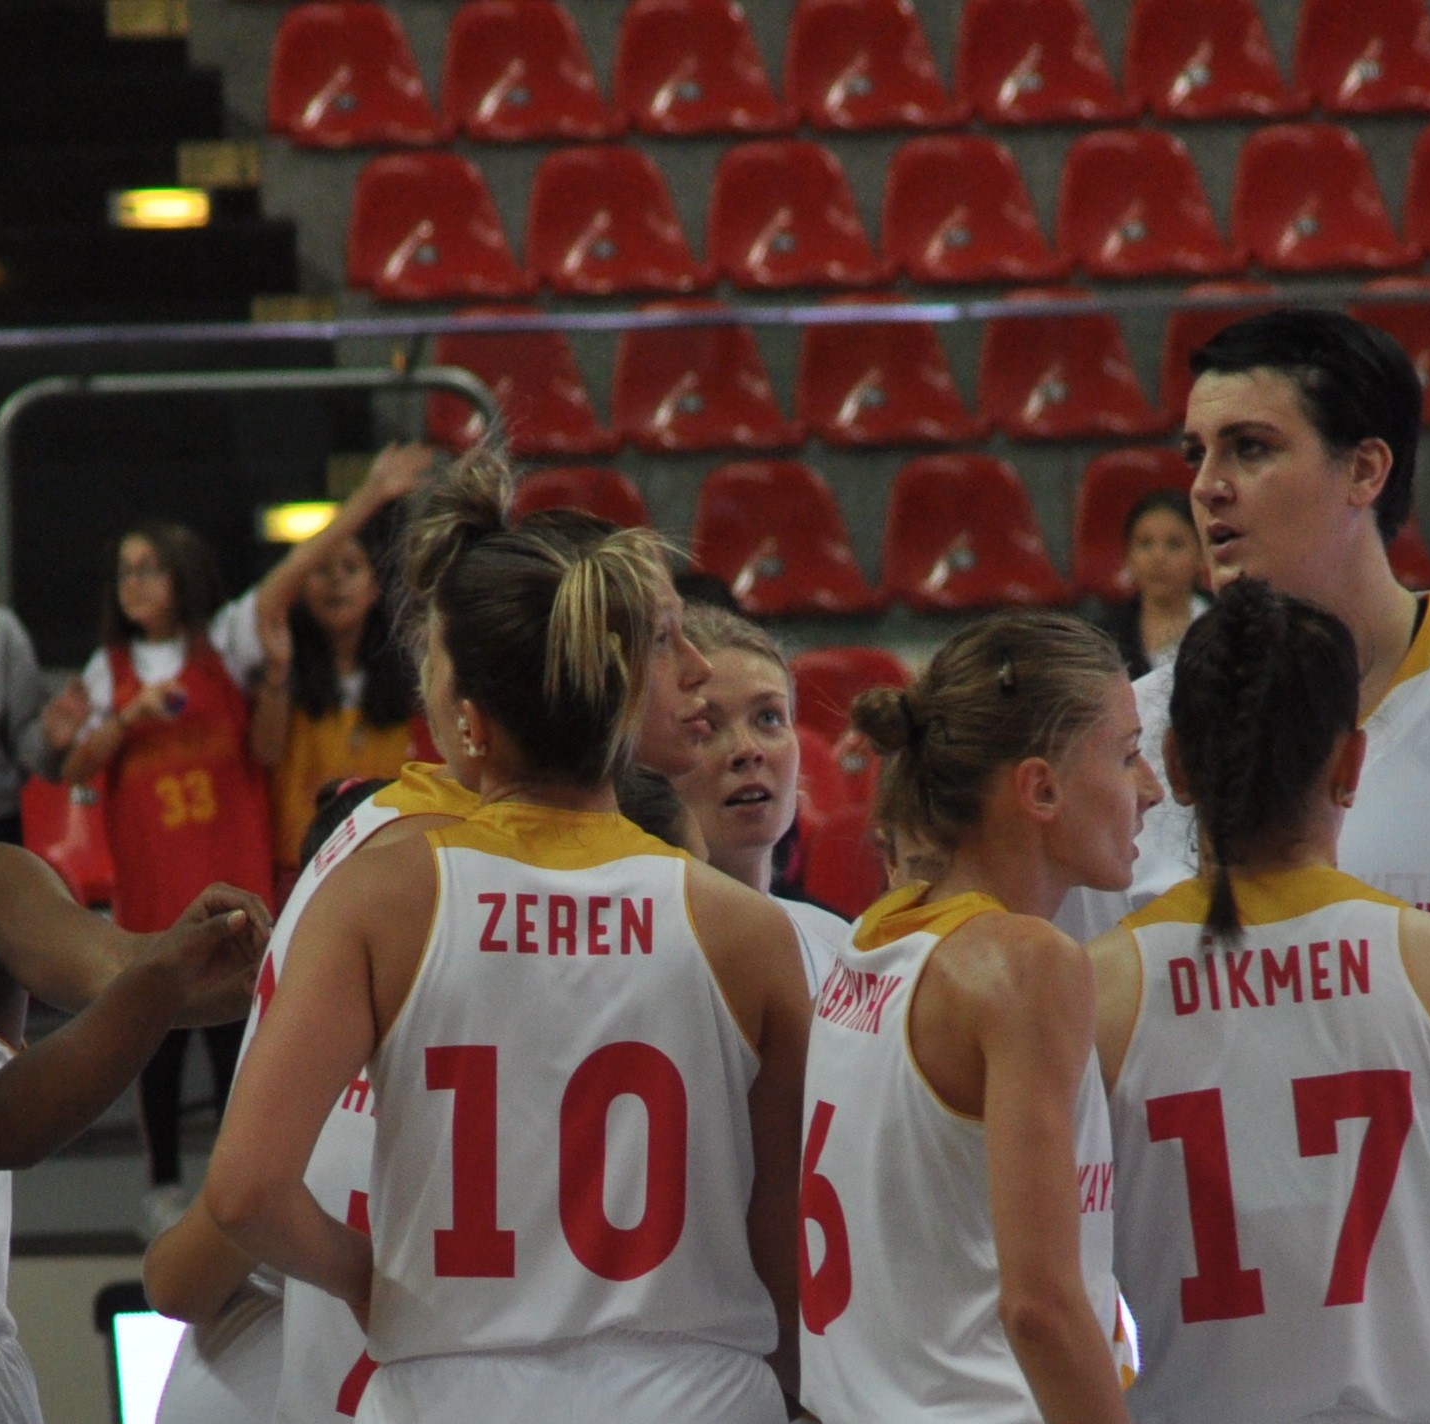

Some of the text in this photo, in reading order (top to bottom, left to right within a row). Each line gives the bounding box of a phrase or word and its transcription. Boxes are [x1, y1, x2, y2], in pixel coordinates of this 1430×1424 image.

[478, 892, 654, 956] ZEREN
[424, 1040, 688, 1283] 10
[798, 1100, 853, 1337] 6
[1146, 1069, 1413, 1325] 17
